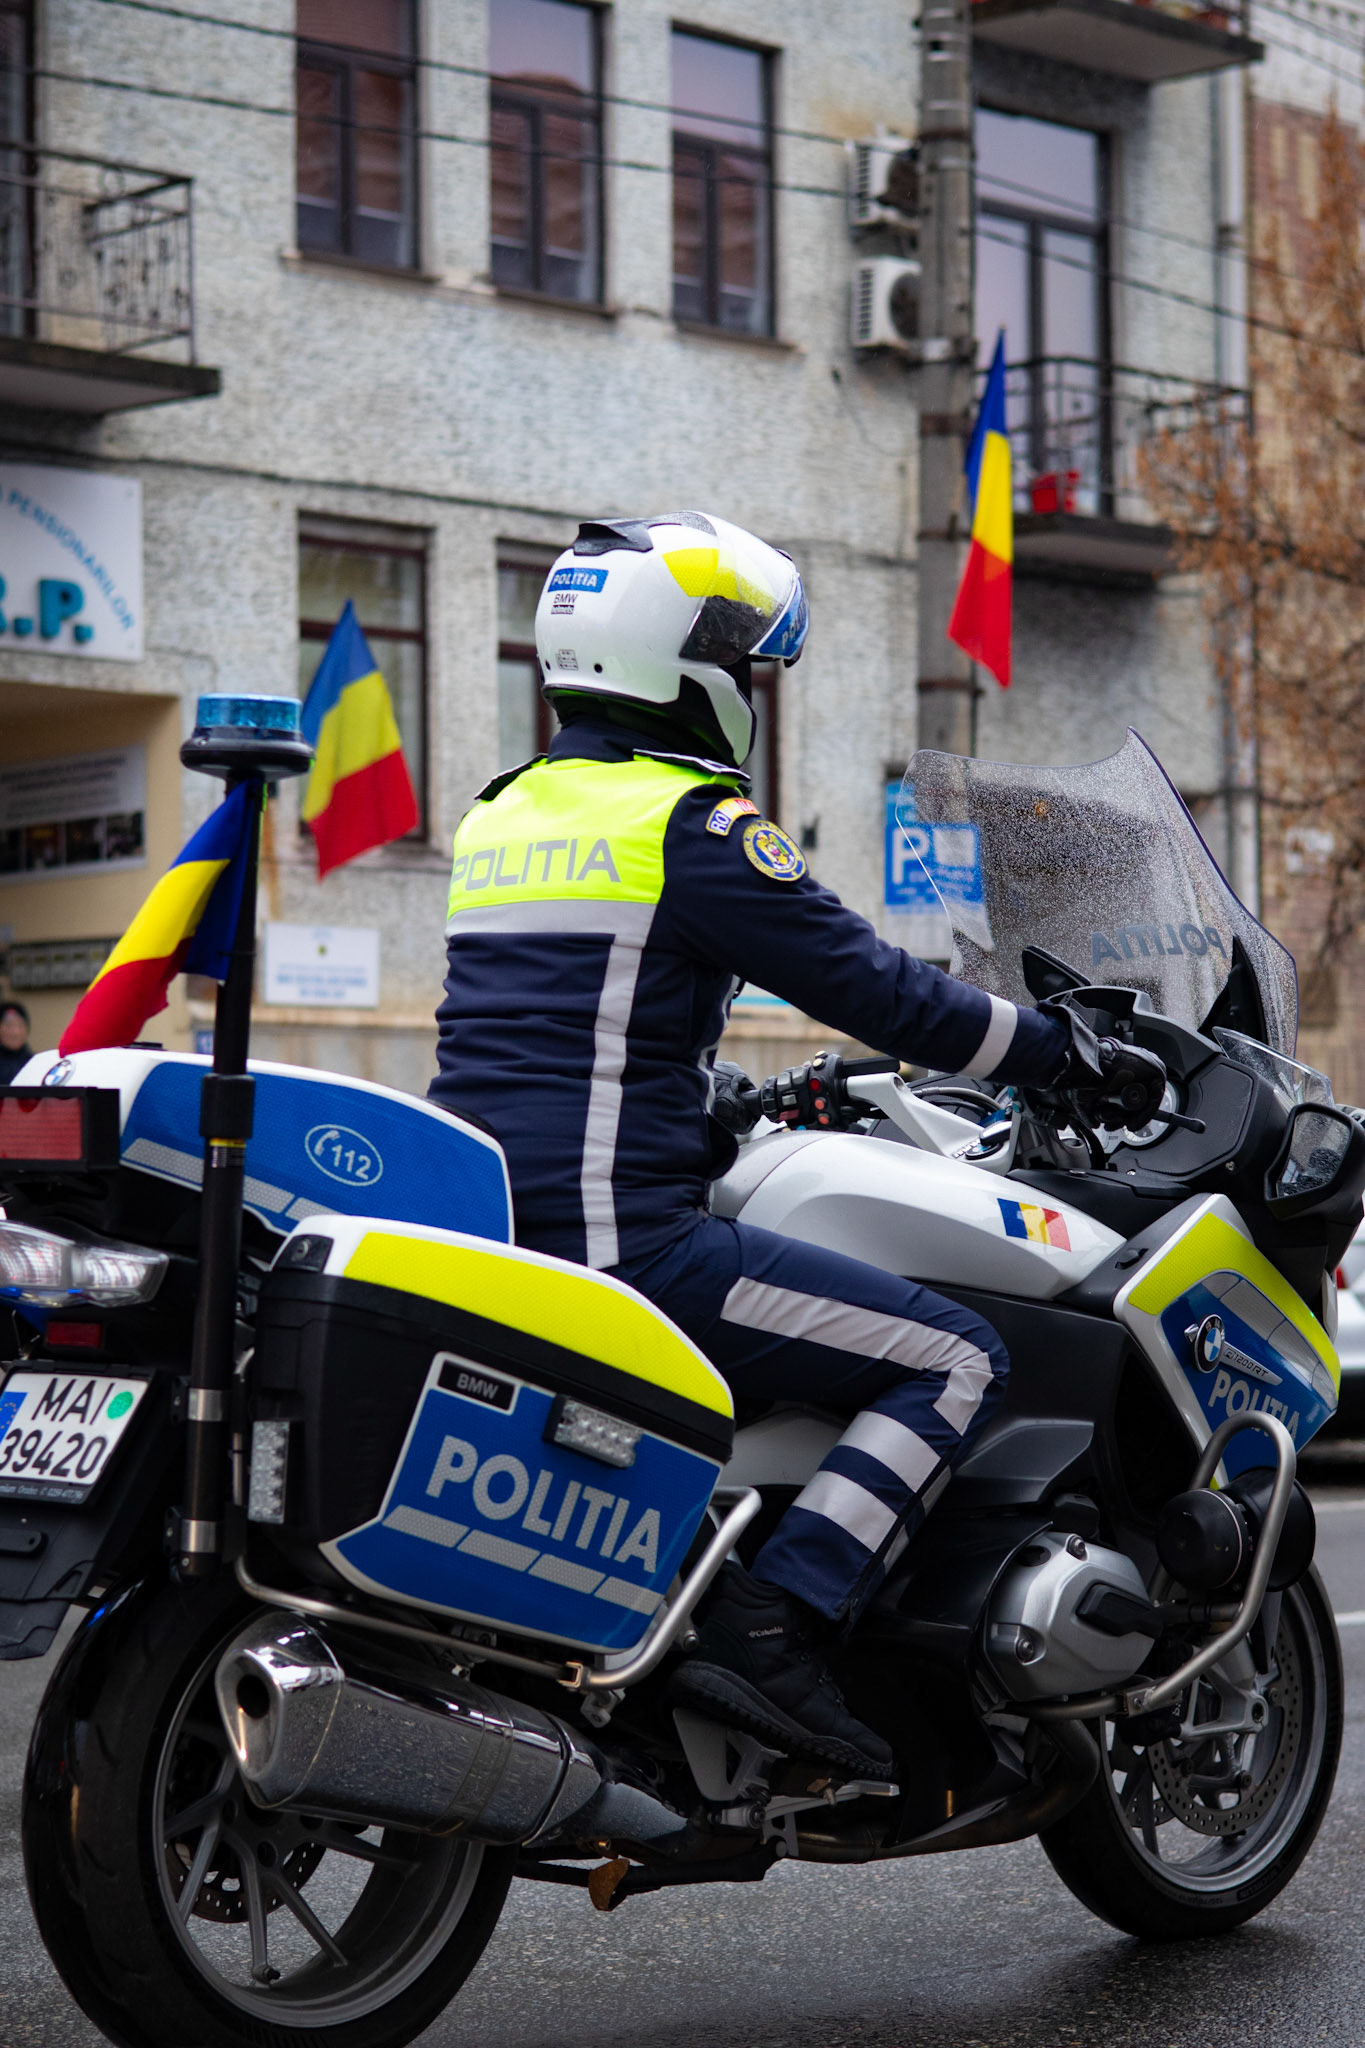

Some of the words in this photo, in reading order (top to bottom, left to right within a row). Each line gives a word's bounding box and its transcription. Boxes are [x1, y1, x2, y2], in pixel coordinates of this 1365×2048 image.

[552, 573, 597, 588] POLITIA
[554, 593, 579, 604] BMW
[0, 570, 94, 644] .P.
[452, 838, 622, 891] POLITIA
[893, 827, 930, 885] P
[332, 1144, 372, 1180] 112
[31, 1377, 116, 1426] MAI
[457, 1373, 499, 1399] BMW
[0, 1428, 108, 1479] 39420
[425, 1434, 661, 1574] POLITIA
